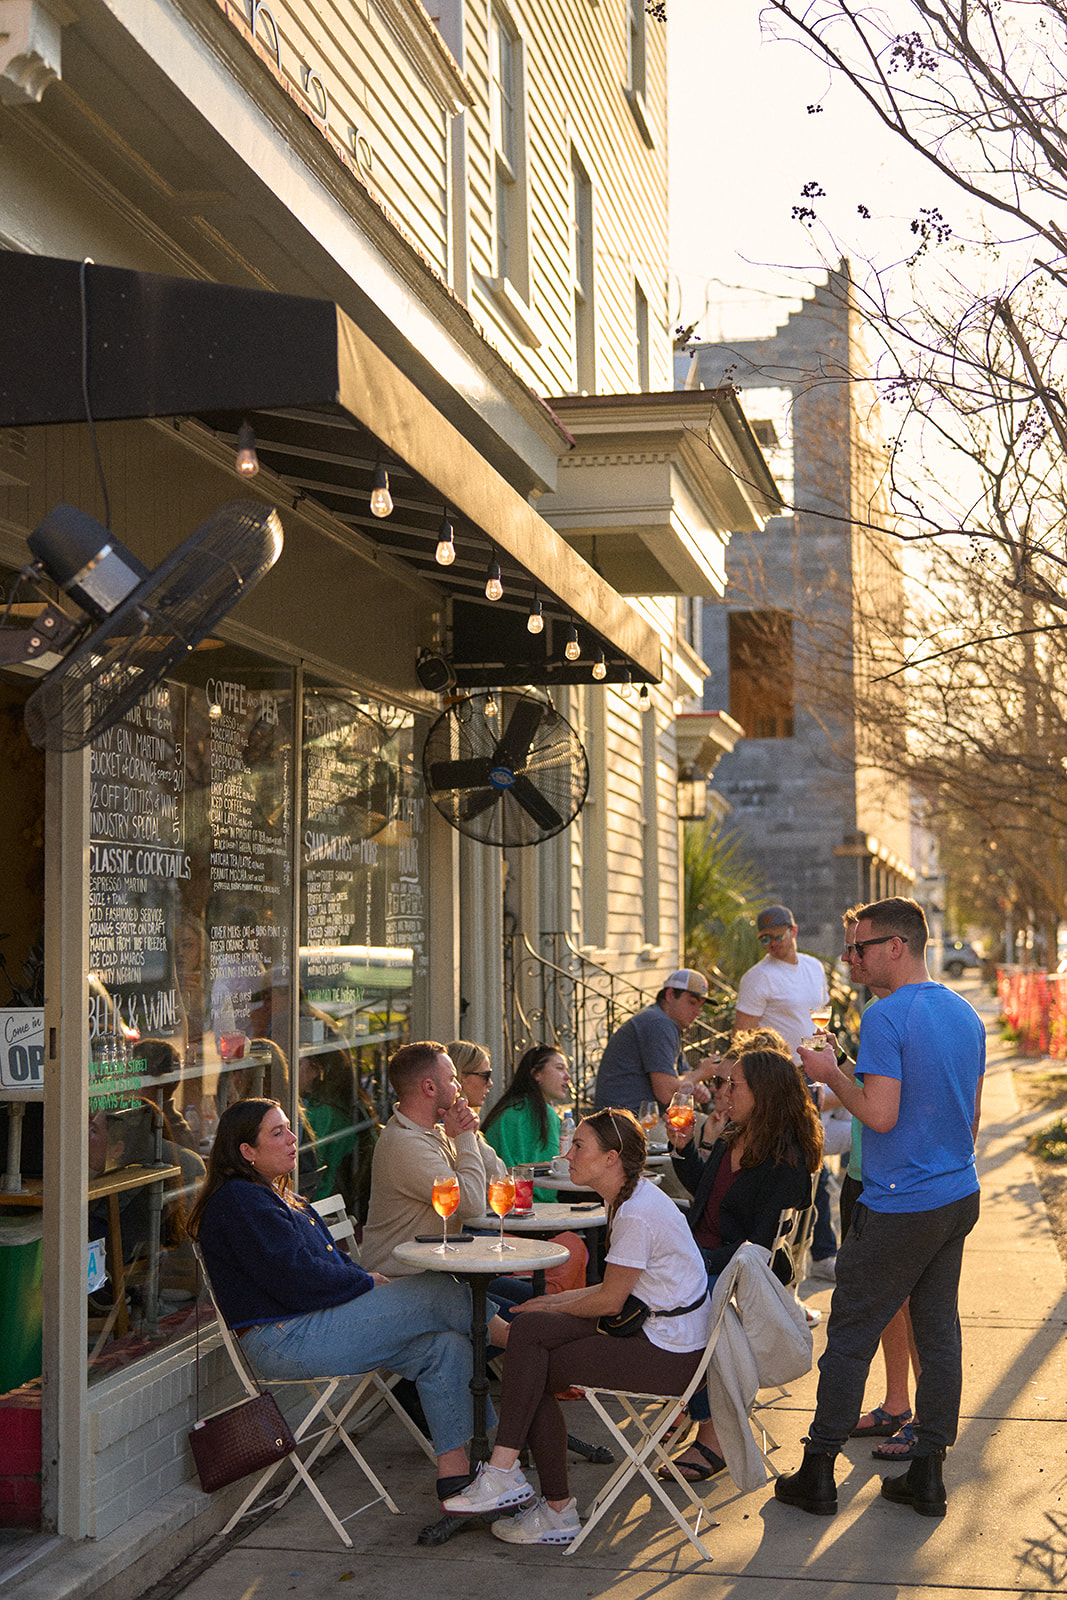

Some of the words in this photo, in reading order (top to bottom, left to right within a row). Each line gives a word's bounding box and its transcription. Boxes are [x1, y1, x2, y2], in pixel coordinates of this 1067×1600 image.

[206, 678, 247, 715] COFFEE
[260, 694, 279, 726] TEA
[117, 727, 132, 755] GIN
[135, 733, 165, 761] MARTINI
[175, 742, 182, 766] 5
[210, 739, 236, 757] CORTADO
[90, 749, 121, 779] BUCKET
[129, 757, 157, 785] ORANGE
[173, 769, 184, 792] 30
[211, 767, 226, 783] LATTE
[210, 781, 224, 796] DRIP
[223, 782, 243, 799] COFFEE
[101, 784, 121, 809] OFF
[123, 786, 154, 815] BOTTLES
[160, 793, 178, 821] WINE
[211, 795, 223, 809] ICED
[224, 797, 243, 813] COFFEE
[90, 811, 129, 839] INDUSTRY
[132, 815, 161, 842] SPECIAL
[172, 820, 181, 845] 5
[304, 830, 353, 863] SANDWICHES
[90, 845, 134, 875] CLASSIC
[135, 849, 192, 881] COCKTAILS
[90, 877, 122, 892] ESPRESSO
[123, 877, 148, 893] MARTINI
[89, 893, 105, 906] SUZE
[112, 893, 128, 905] TONIC
[90, 907, 102, 922] OLD
[105, 907, 138, 922] FASHIONED
[140, 907, 164, 922] SERVICE
[90, 921, 114, 937] ORANGE
[115, 921, 137, 935] SPRITZ
[137, 922, 147, 935] ON
[147, 920, 166, 935] DRAFT
[90, 937, 115, 952] MARTINI
[116, 936, 131, 952] FROM
[144, 936, 168, 952] FREEZER
[210, 939, 226, 953] FRESH
[226, 938, 245, 951] ORANGE
[246, 938, 260, 950] JUICE
[90, 952, 100, 967] ICE
[102, 952, 118, 967] COLD
[120, 951, 145, 967] AMAROS
[116, 966, 142, 985] NEGRONI
[89, 993, 123, 1041] BEER
[128, 991, 140, 1034] &
[142, 989, 181, 1032] WINE
[5, 1016, 30, 1043] Come
[32, 1016, 42, 1029] in
[88, 1252, 97, 1278] A
